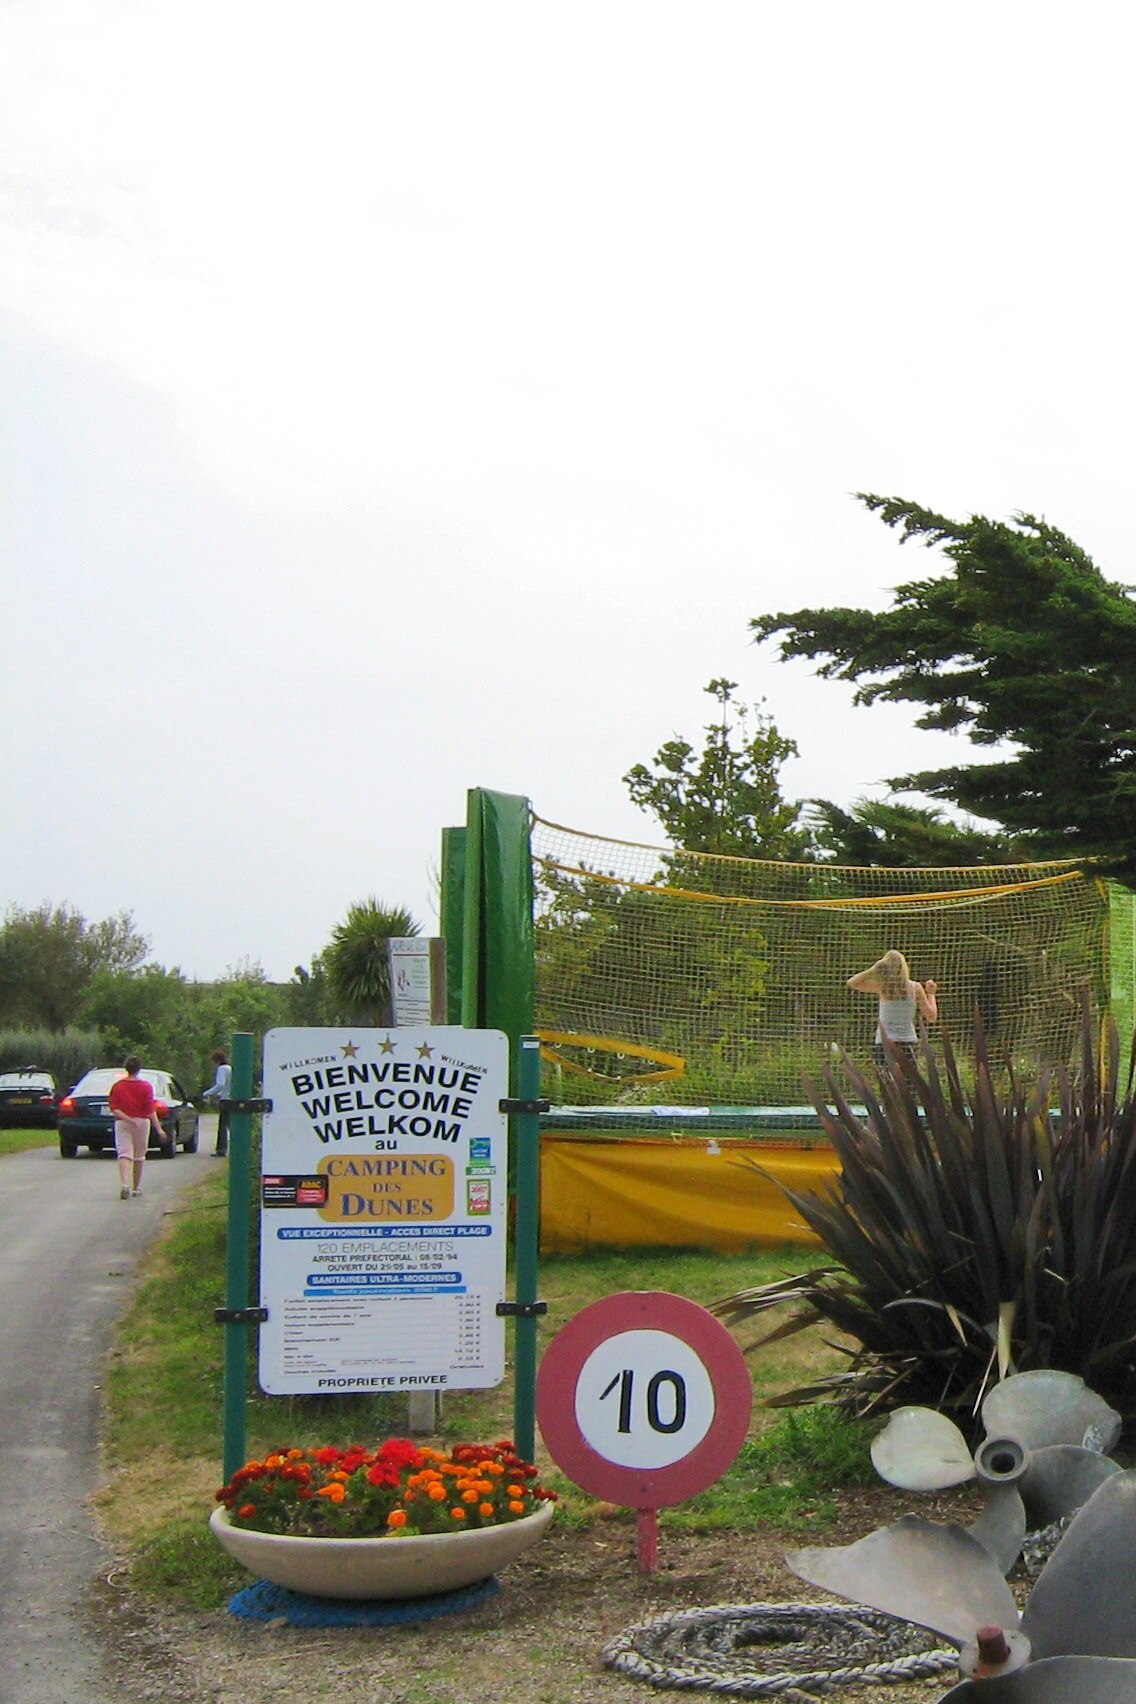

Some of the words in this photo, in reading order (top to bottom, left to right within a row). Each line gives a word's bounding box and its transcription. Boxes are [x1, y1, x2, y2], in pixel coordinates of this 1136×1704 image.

[291, 1062, 482, 1096] BIENVENUE
[301, 1088, 473, 1119] WELCOME
[313, 1115, 461, 1143] WELKOM
[375, 1139, 398, 1150] au
[327, 1159, 446, 1177] CAMPING
[373, 1183, 401, 1193] DES
[341, 1193, 433, 1216] DUNES
[282, 1229, 301, 1238] VUE
[303, 1229, 383, 1238] EXCEPTIONNELLE
[423, 1228, 455, 1236] DIRECT
[457, 1227, 487, 1235] PLAGE
[317, 1243, 338, 1254] 120
[342, 1241, 454, 1253] EMPLACEMENTS
[312, 1276, 368, 1284] SANITAIRES
[318, 1377, 395, 1387] PROPRIETE
[400, 1375, 448, 1385] PRIVEE
[599, 1369, 687, 1434] 10
